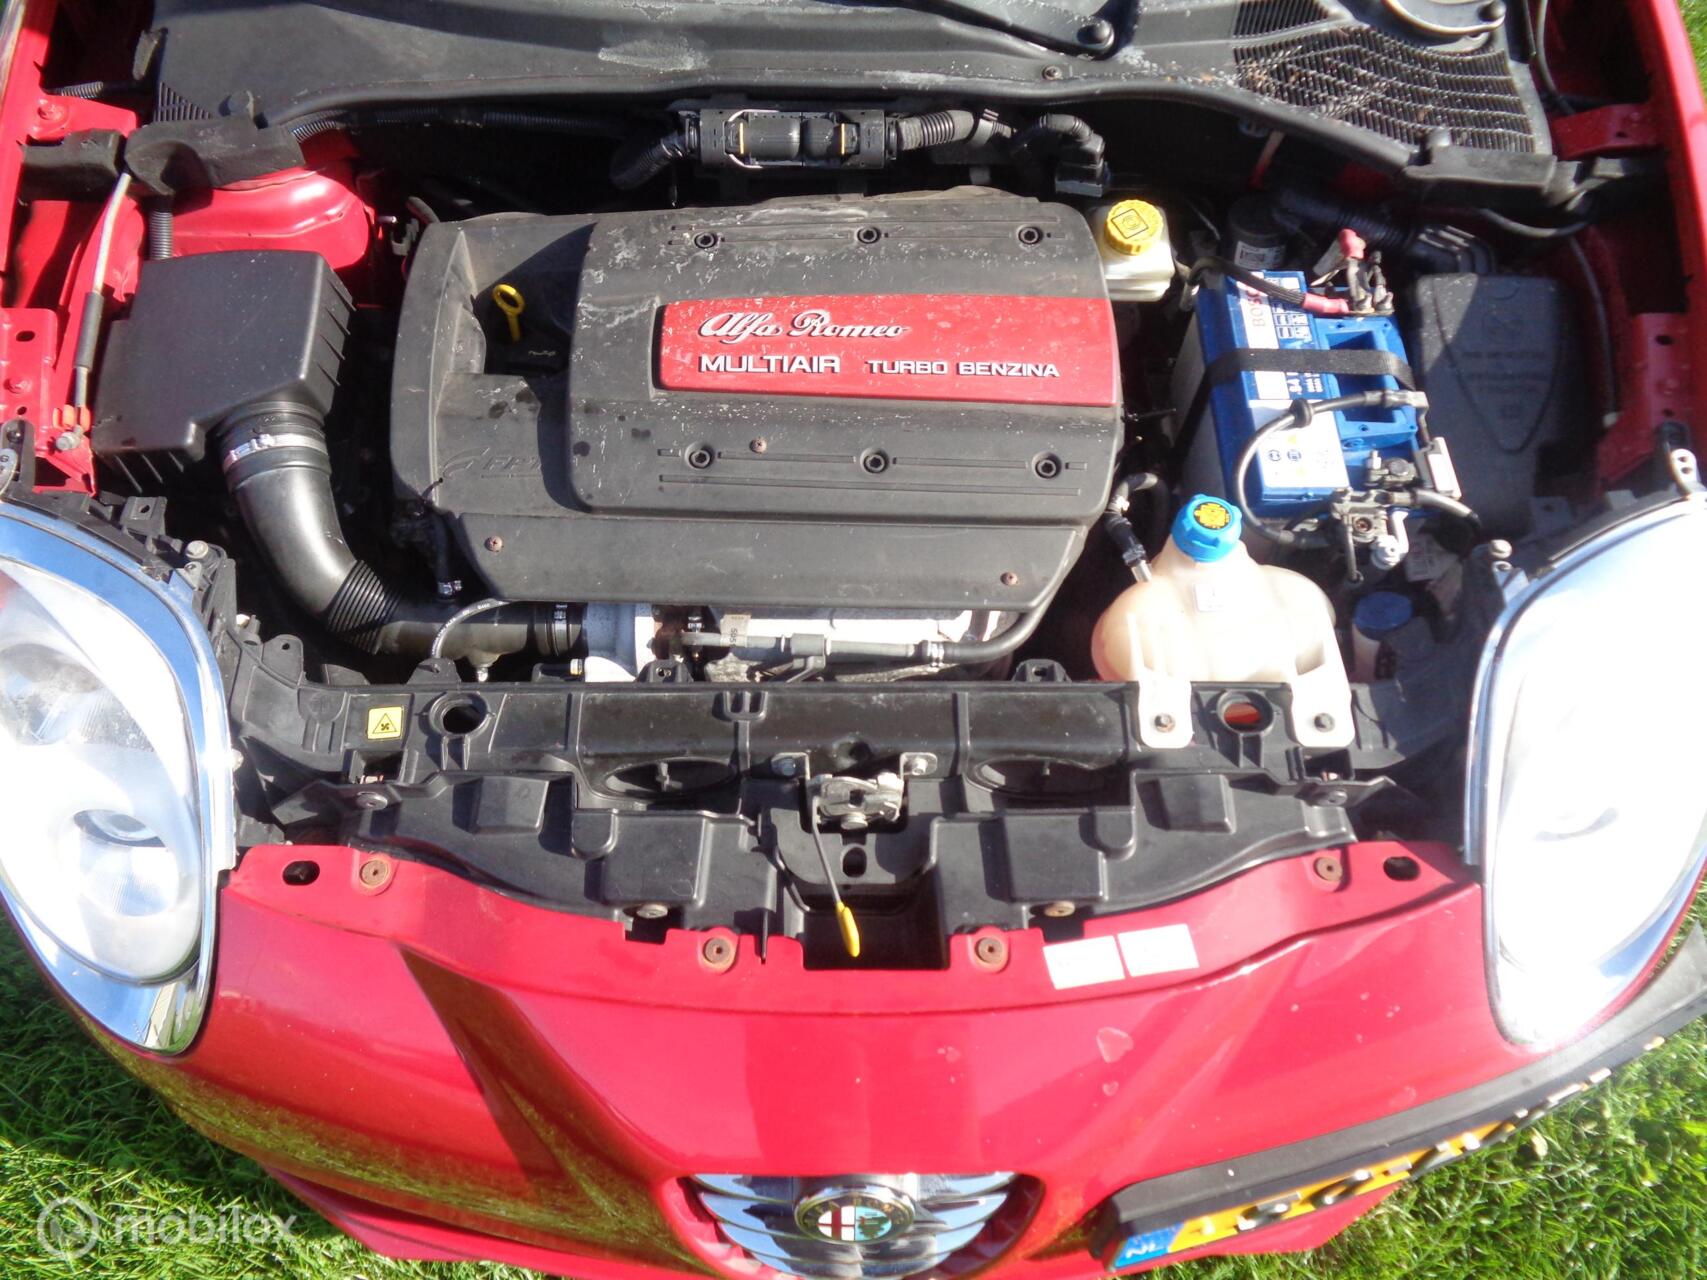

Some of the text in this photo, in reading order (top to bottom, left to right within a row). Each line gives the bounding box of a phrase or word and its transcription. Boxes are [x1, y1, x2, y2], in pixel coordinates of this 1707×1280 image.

[1247, 288, 1266, 327] BOSC
[698, 309, 909, 344] Alfa Romeo
[698, 354, 1061, 379] MULTIAIR TURBO BENZINA
